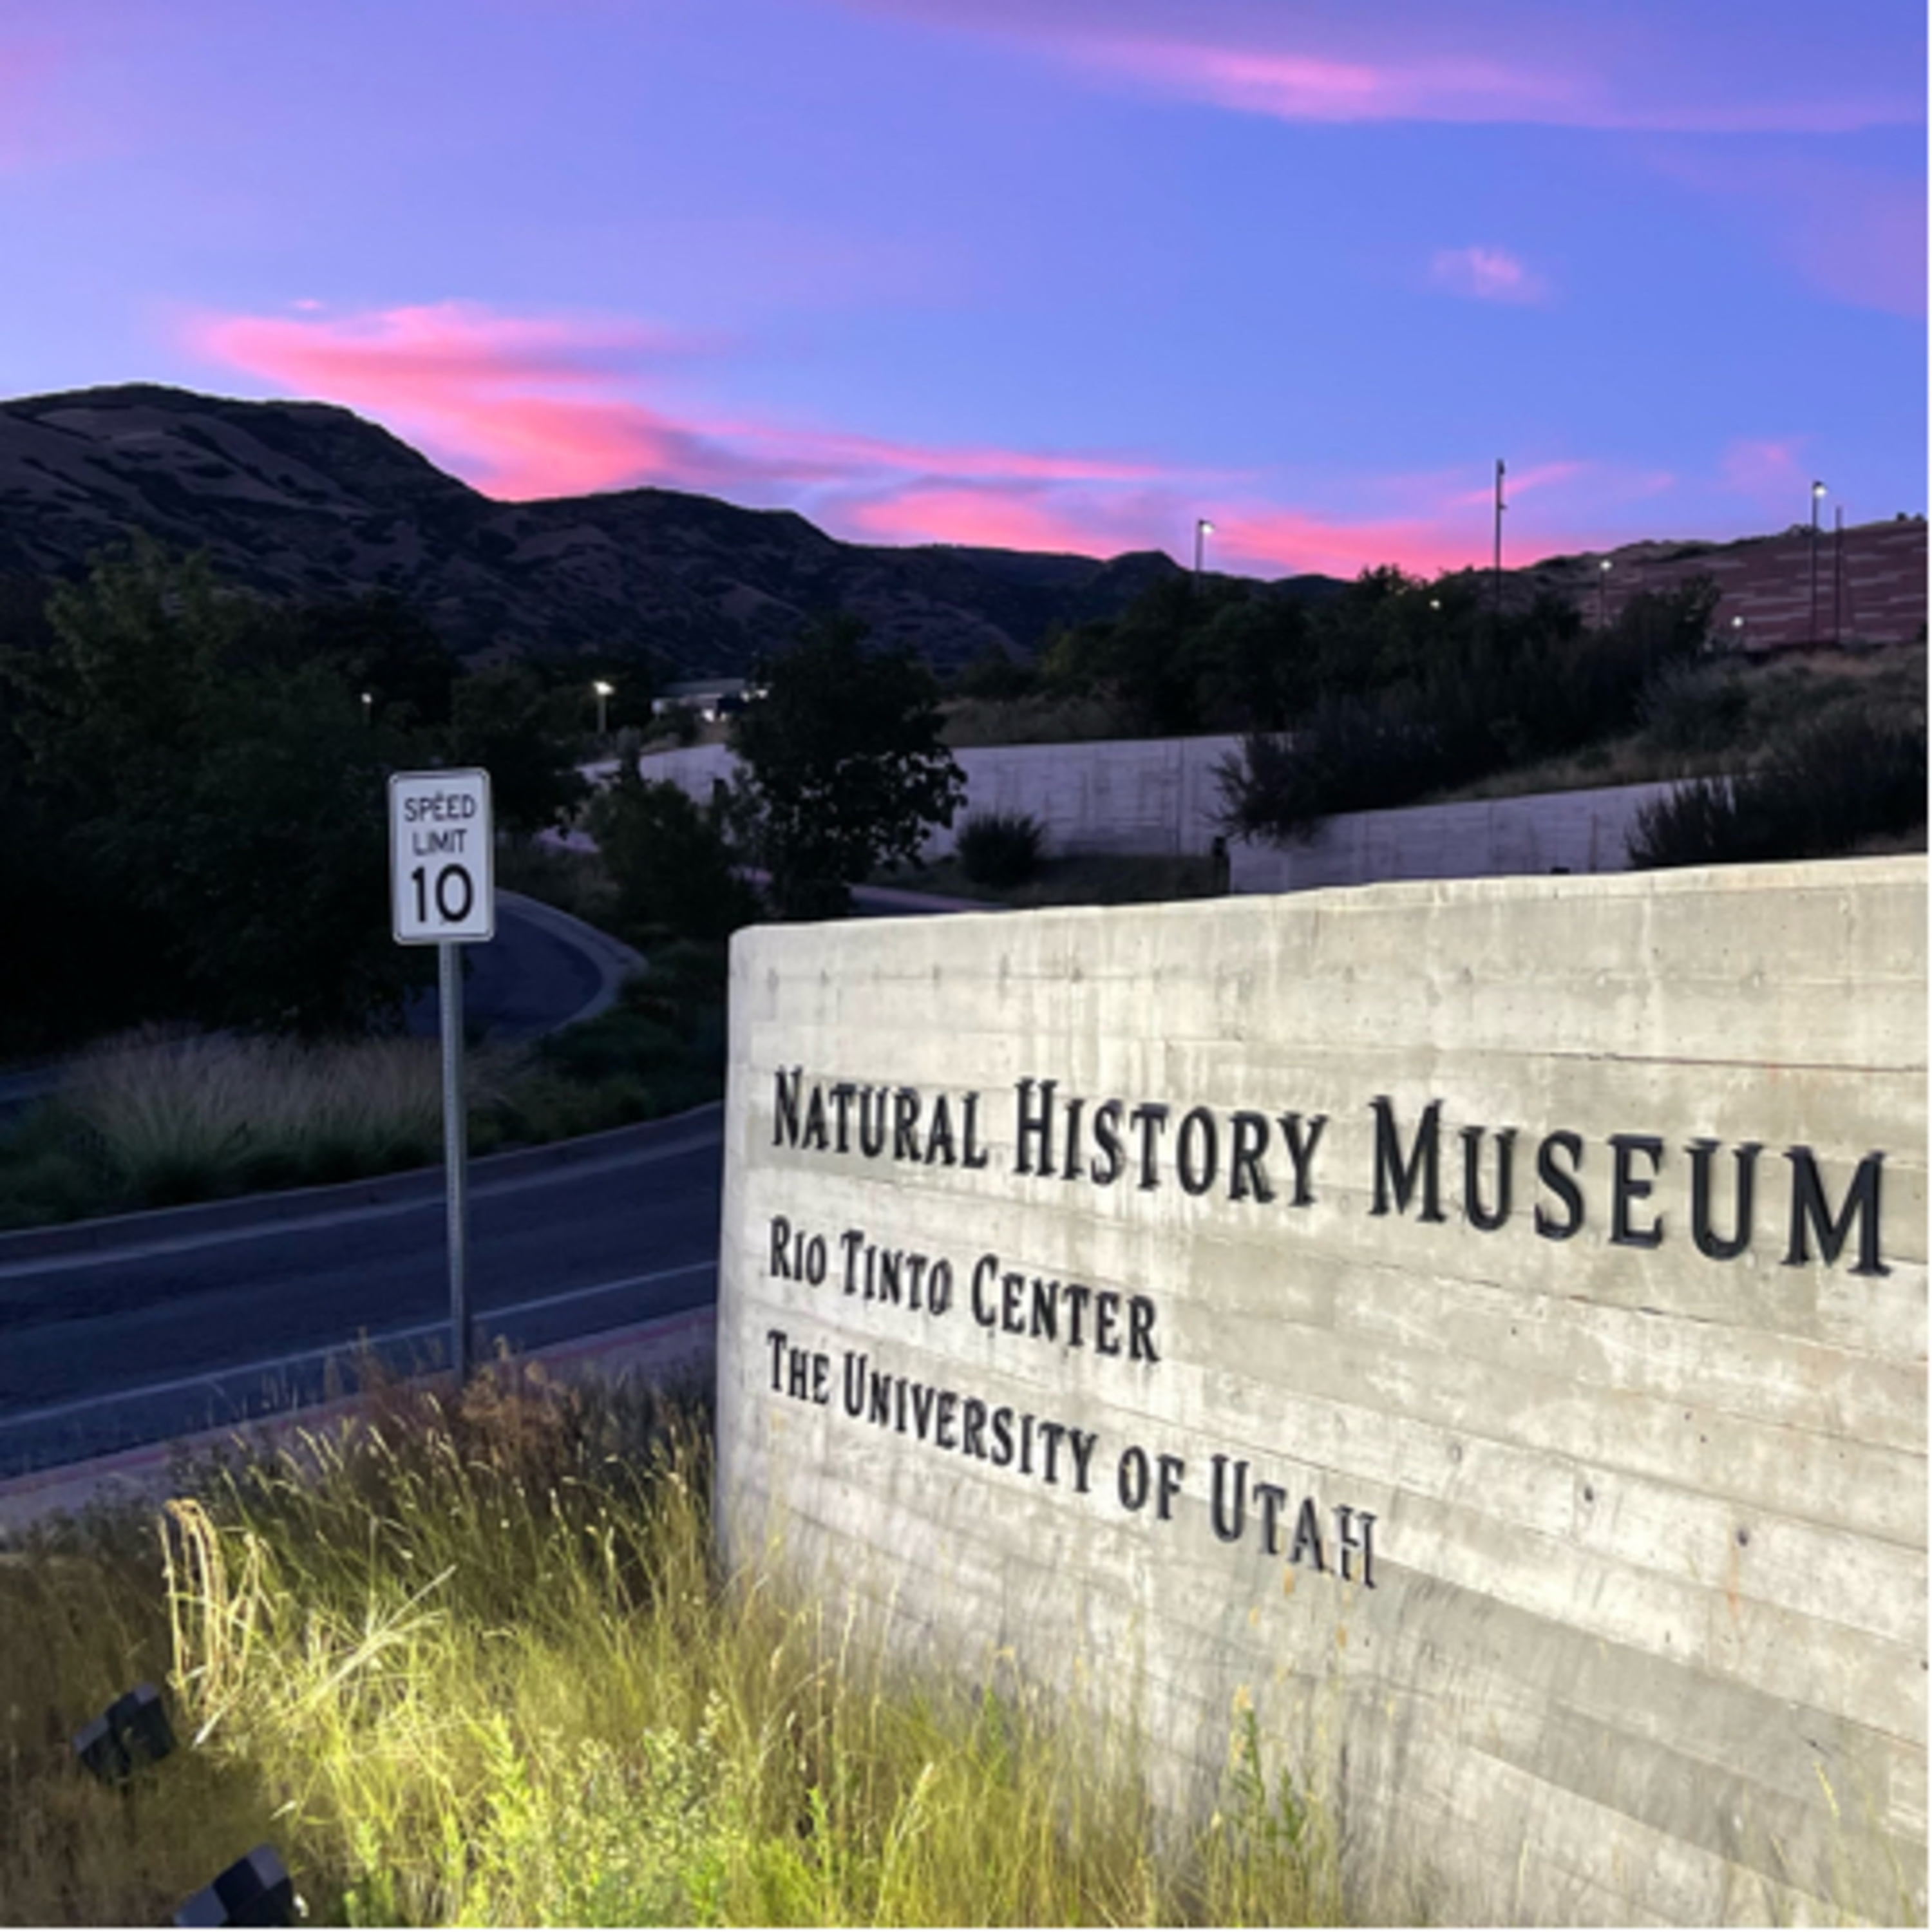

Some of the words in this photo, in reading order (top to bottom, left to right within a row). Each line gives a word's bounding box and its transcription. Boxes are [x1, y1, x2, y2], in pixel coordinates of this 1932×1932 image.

[404, 794, 476, 822] SPEED
[412, 828, 467, 856] LIMIT
[411, 863, 474, 923] 10
[772, 1066, 989, 1169] NATURAL
[1014, 1077, 1329, 1207] HISTORY
[1367, 1095, 1892, 1277] MUSEUM
[771, 1215, 827, 1286] RIO
[840, 1229, 952, 1316] TINTO
[971, 1254, 1160, 1363] CENTER
[767, 1330, 830, 1405] THE
[843, 1352, 1099, 1494] UNIVERSITY
[1117, 1446, 1186, 1521] OF
[1211, 1454, 1378, 1589] UTAH
